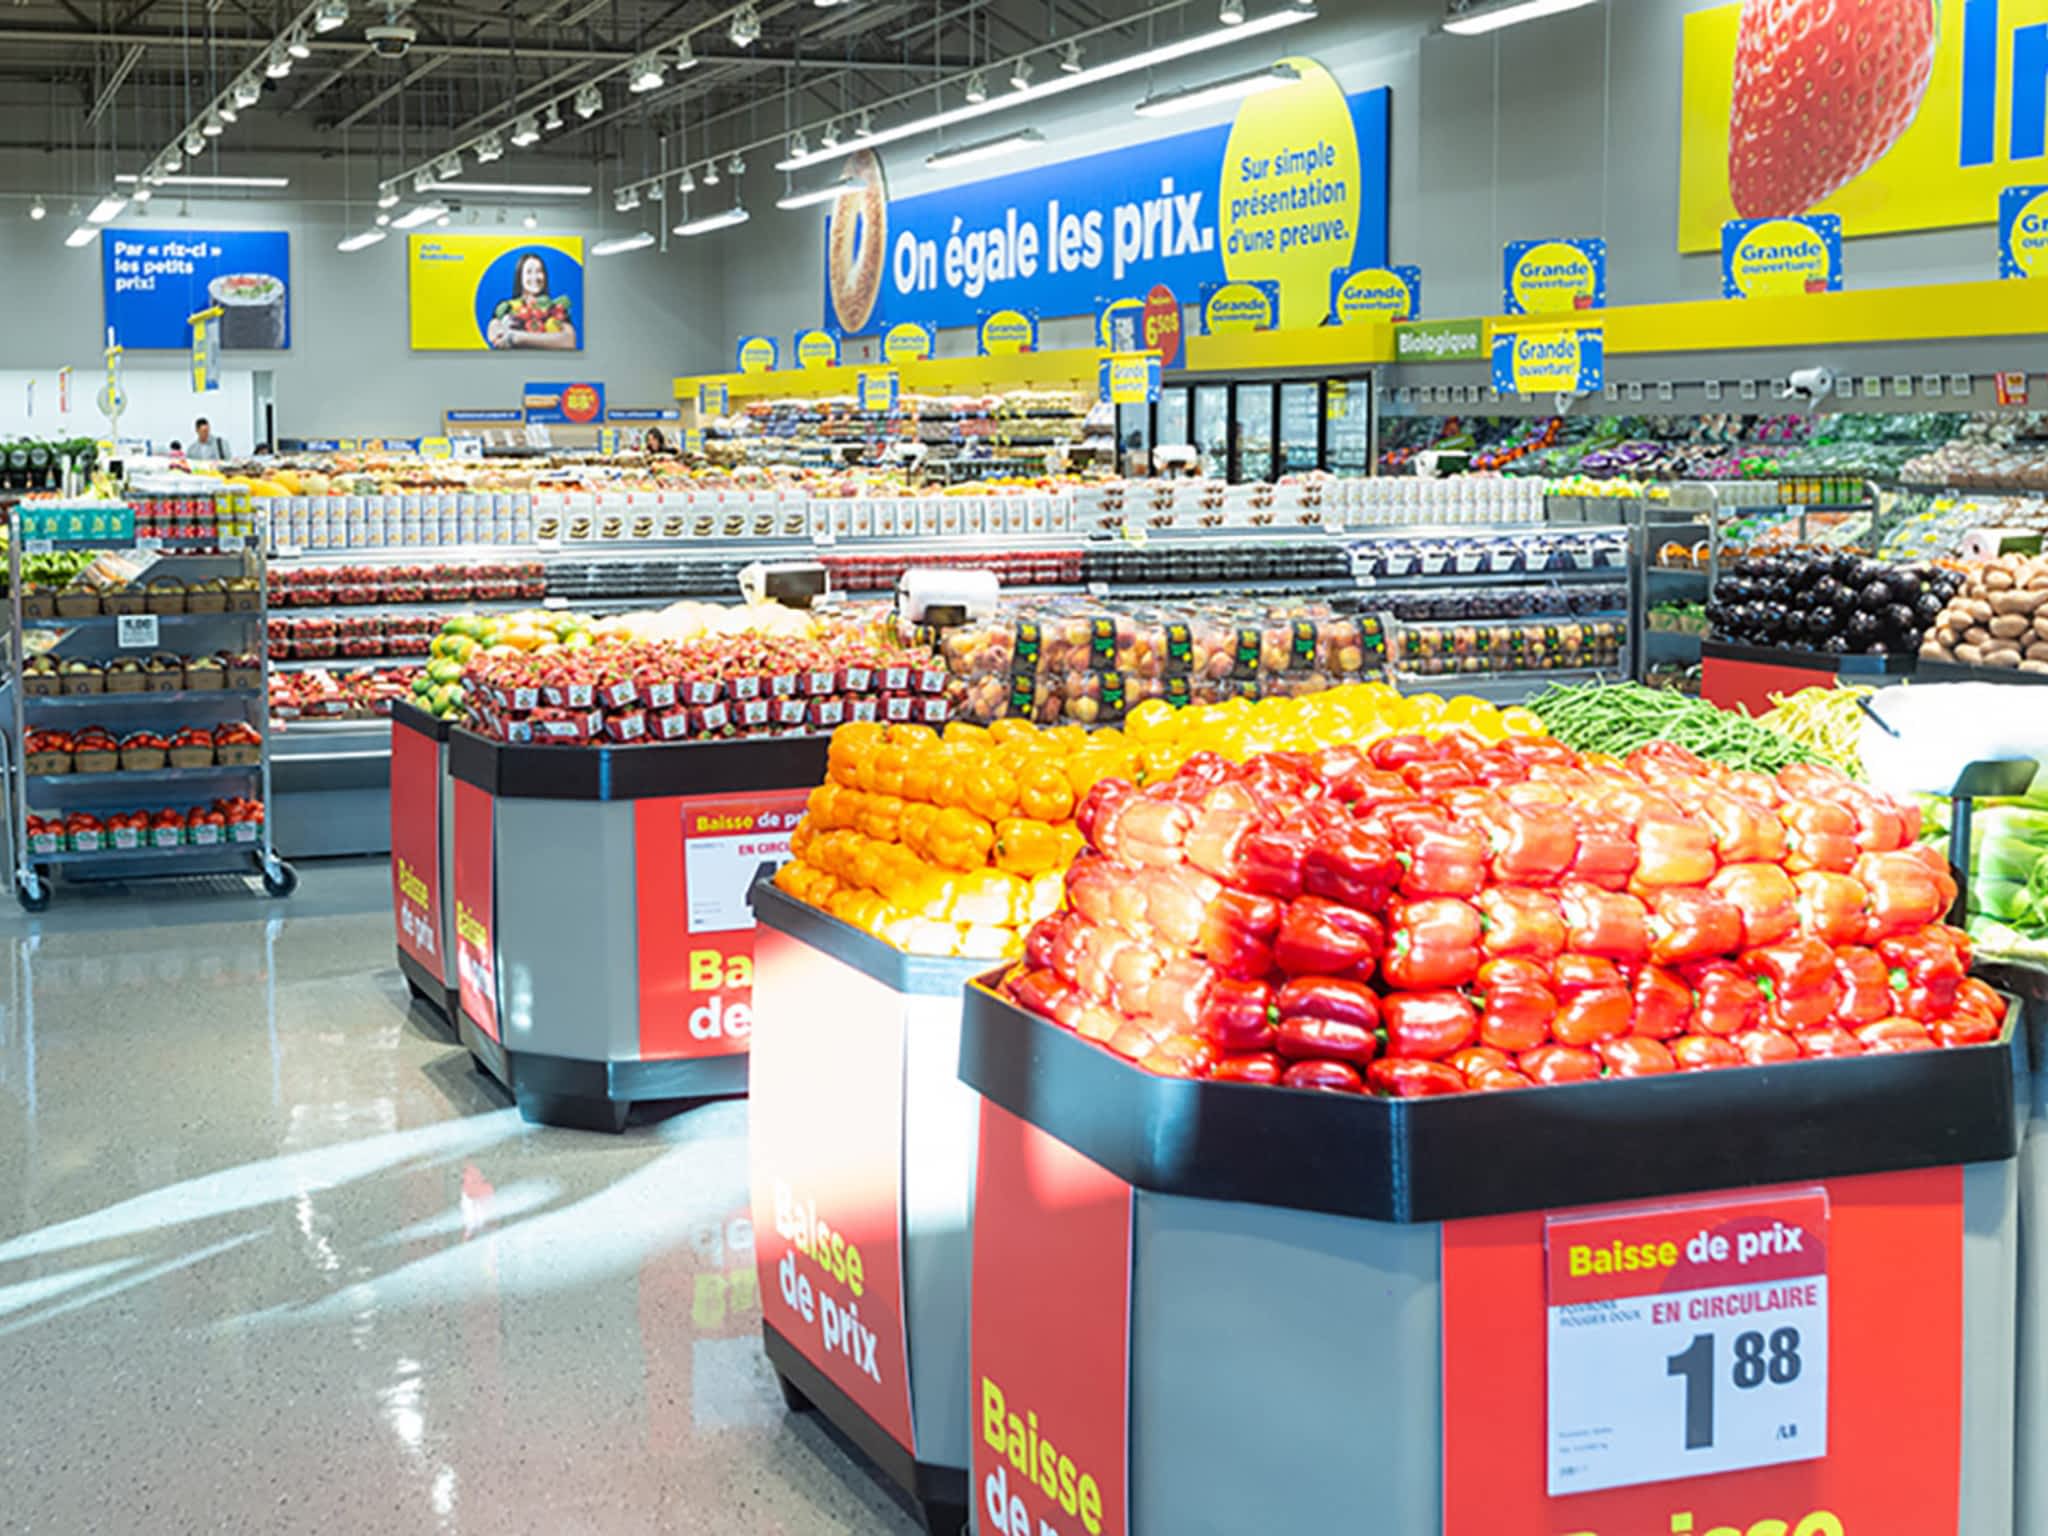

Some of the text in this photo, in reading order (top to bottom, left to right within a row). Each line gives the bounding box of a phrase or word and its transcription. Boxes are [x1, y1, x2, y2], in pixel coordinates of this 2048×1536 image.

[1241, 140, 1335, 182] Sur simple
[1232, 178, 1346, 224] présentation
[115, 241, 144, 256] Par
[893, 178, 1214, 298] On égale les prix.
[1227, 219, 1349, 254] d'une preuve.
[1741, 241, 1821, 260] Grande
[115, 259, 194, 275] les petits
[1519, 262, 1588, 277] Grande
[1741, 258, 1821, 274] ouverture!
[1212, 299, 1265, 311] Grande
[1343, 285, 1405, 299] Grande
[1398, 331, 1477, 355] Biologique
[1518, 340, 1575, 361] Grande
[697, 816, 753, 831] Baisse
[758, 811, 780, 828] de
[738, 845, 754, 856] EN
[689, 949, 753, 992] Ba
[688, 995, 752, 1040] de
[775, 1176, 864, 1297] Baisse
[1569, 1222, 1803, 1277] Baisse de prix
[779, 1249, 815, 1323] de
[819, 1289, 881, 1384] prix
[1652, 1284, 1818, 1325] EN CIRCULAIRE
[1667, 1326, 1801, 1451] 1 88
[981, 1375, 1103, 1536] Baisse
[985, 1465, 1031, 1536] de
